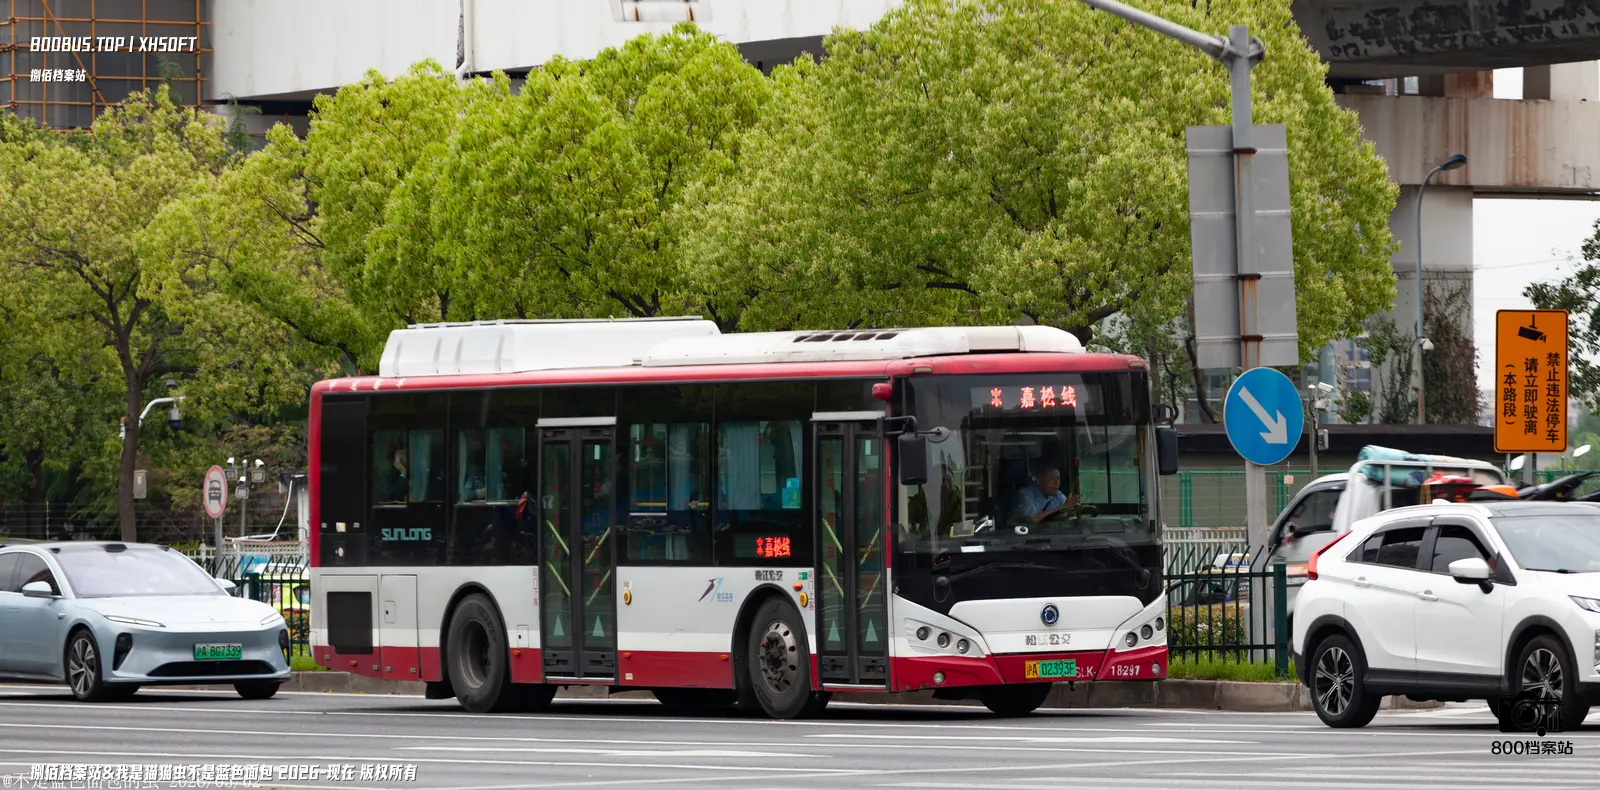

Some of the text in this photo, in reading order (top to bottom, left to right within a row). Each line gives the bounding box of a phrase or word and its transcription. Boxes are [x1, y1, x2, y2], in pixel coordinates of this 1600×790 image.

[1020, 386, 1076, 407] 嘉松线
[1523, 357, 1539, 436] 请立即驶离
[1545, 352, 1561, 444] 禁止违法停车
[381, 528, 432, 541] SUNLONG
[765, 537, 791, 558] 嘉松线
[1041, 661, 1075, 676] 02393F
